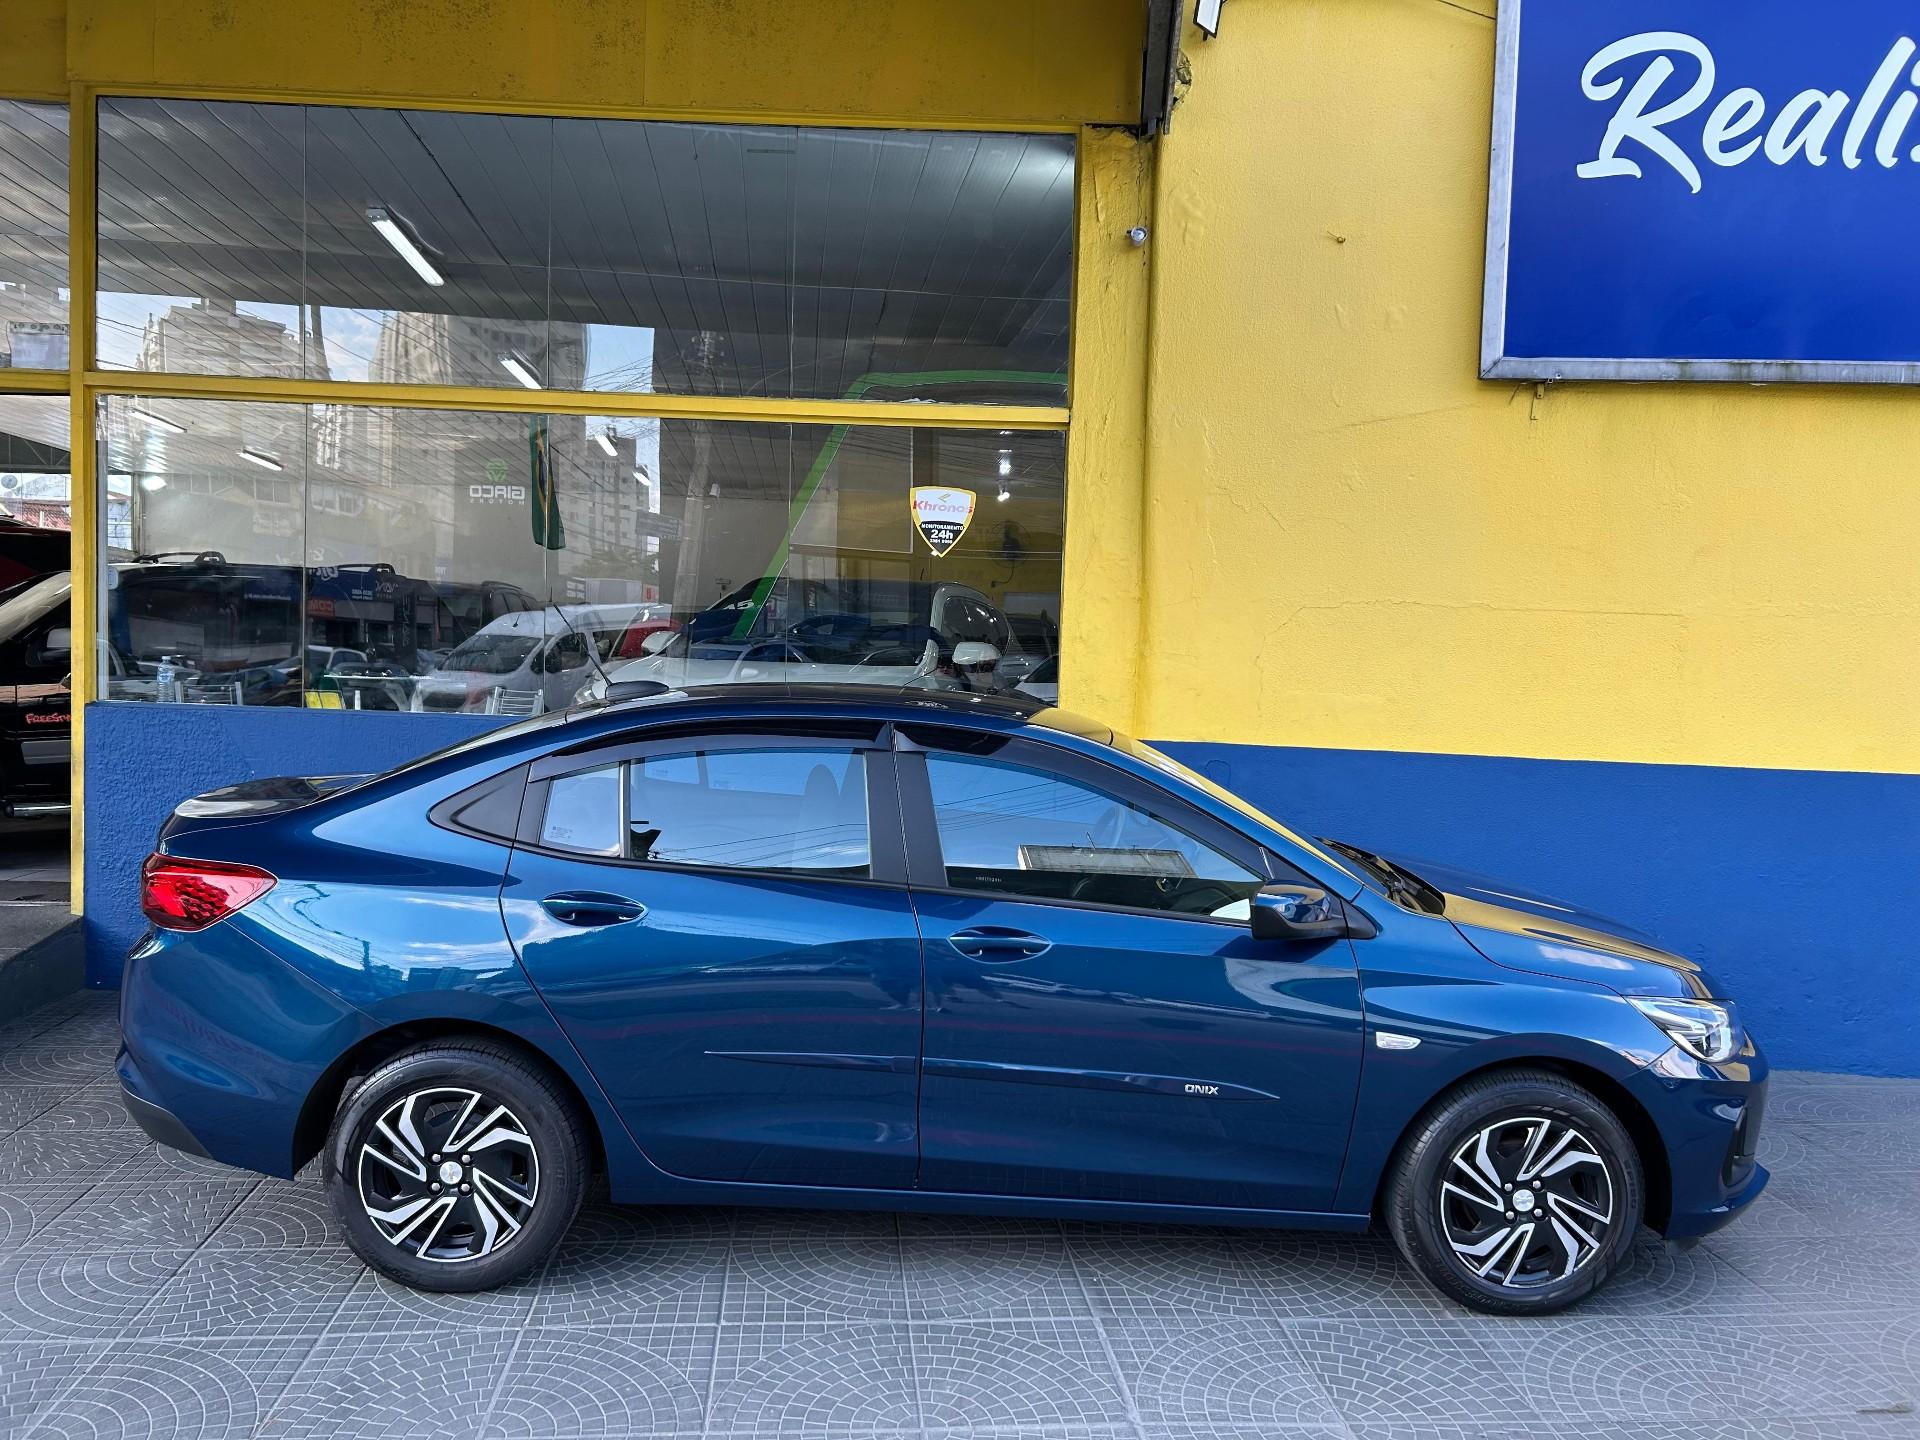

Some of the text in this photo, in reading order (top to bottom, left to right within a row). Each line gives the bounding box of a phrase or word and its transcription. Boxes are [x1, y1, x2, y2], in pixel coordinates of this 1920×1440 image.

[1576, 31, 1920, 194] Reali
[912, 500, 973, 514] Khronos
[921, 523, 964, 531] MONITORAMENTO
[930, 529, 954, 539] 24h
[1184, 1083, 1220, 1096] ONIX
